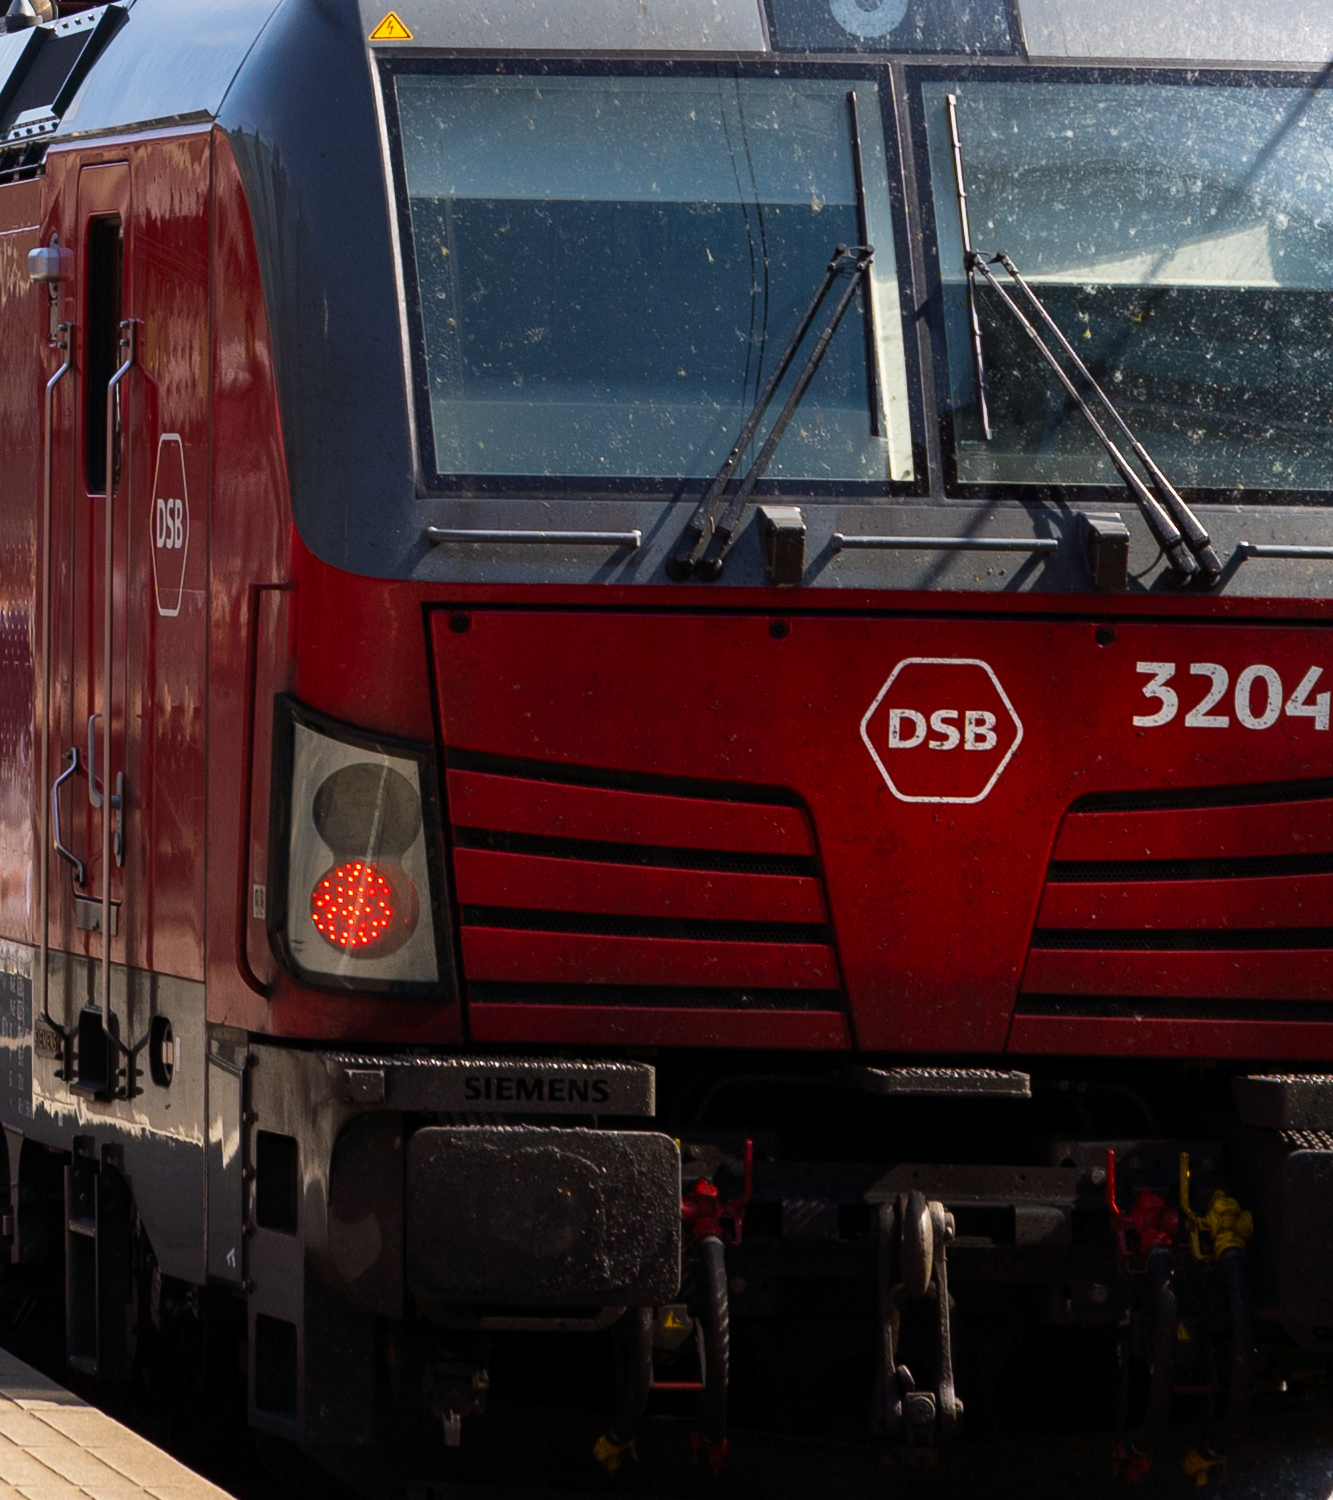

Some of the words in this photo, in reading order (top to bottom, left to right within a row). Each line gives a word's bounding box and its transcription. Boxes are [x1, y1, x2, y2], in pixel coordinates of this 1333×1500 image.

[157, 498, 183, 549] DSB
[1132, 661, 1331, 731] 3204
[888, 708, 997, 751] DSB
[464, 1076, 610, 1103] SIEMENS
